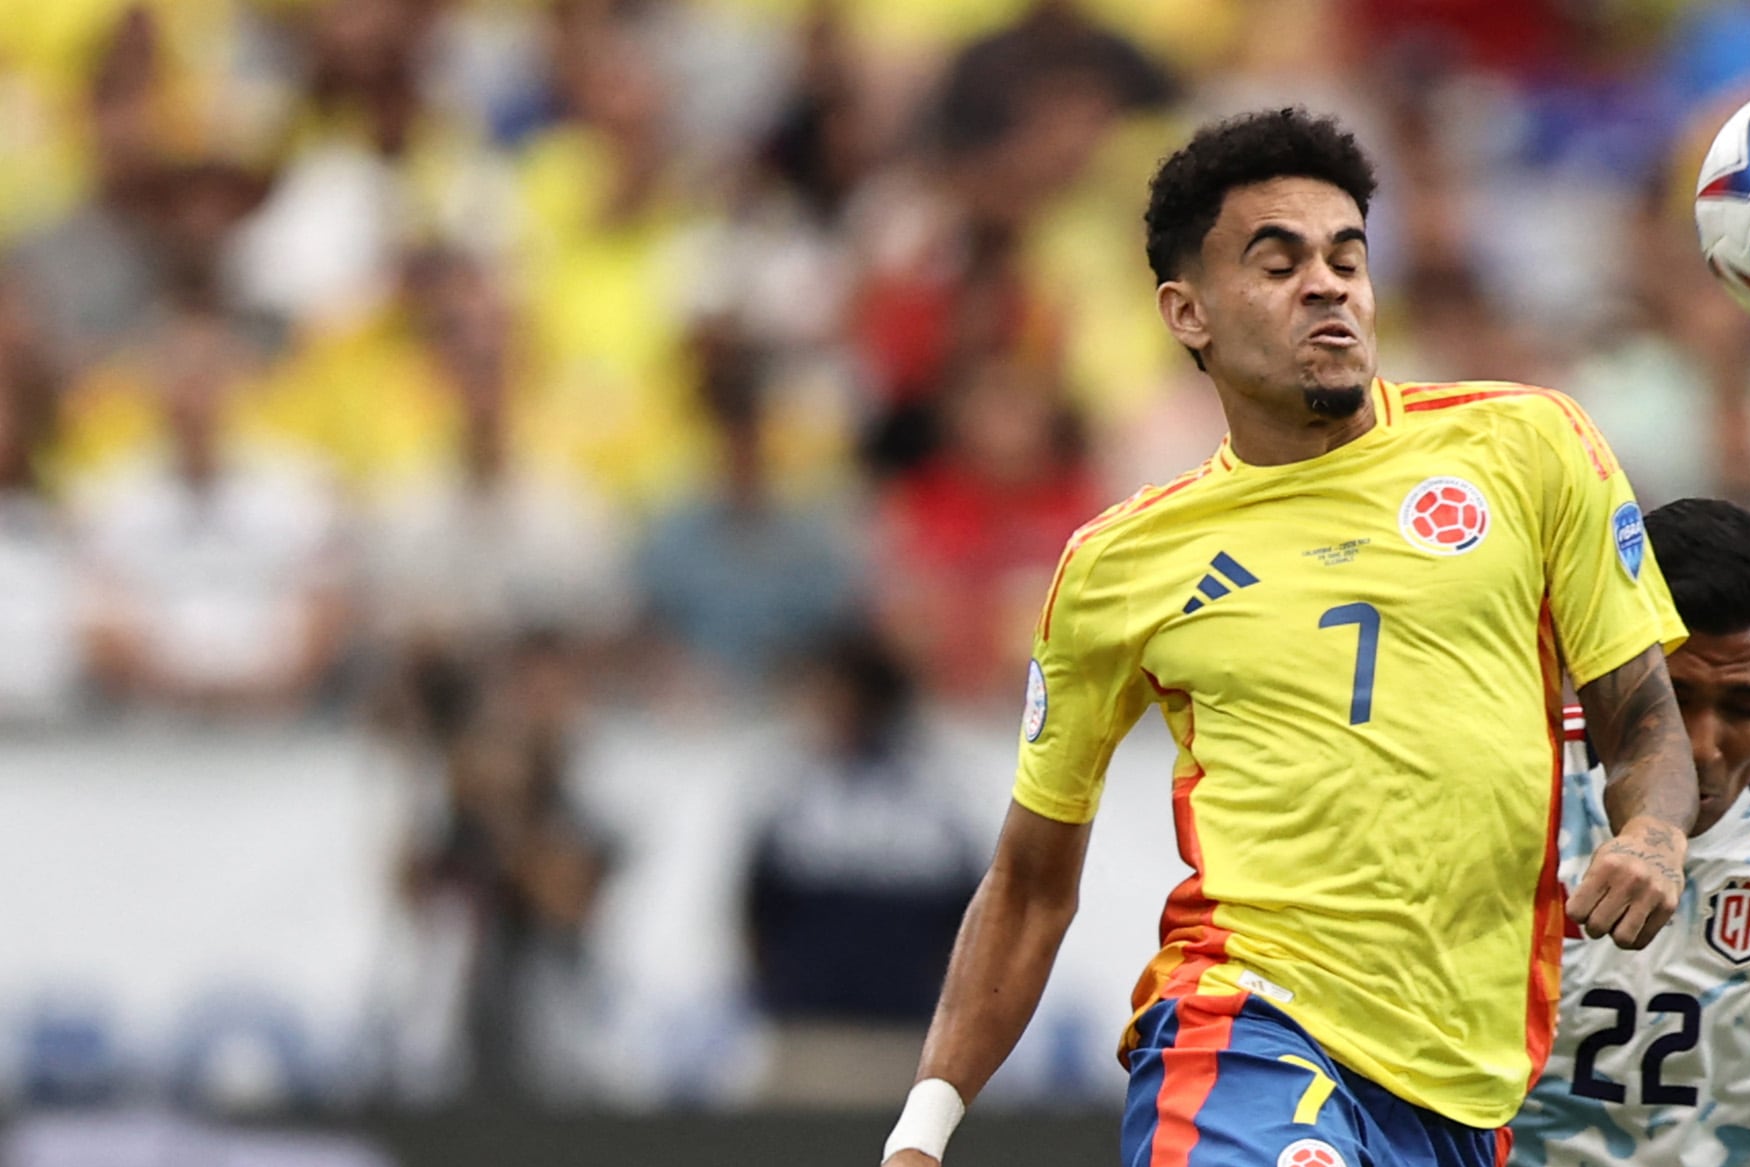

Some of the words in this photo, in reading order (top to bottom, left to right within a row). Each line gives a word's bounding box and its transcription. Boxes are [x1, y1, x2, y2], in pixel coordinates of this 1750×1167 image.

[1318, 601, 1380, 726] 7
[1278, 1054, 1337, 1126] 7
[1570, 988, 1702, 1107] 22
